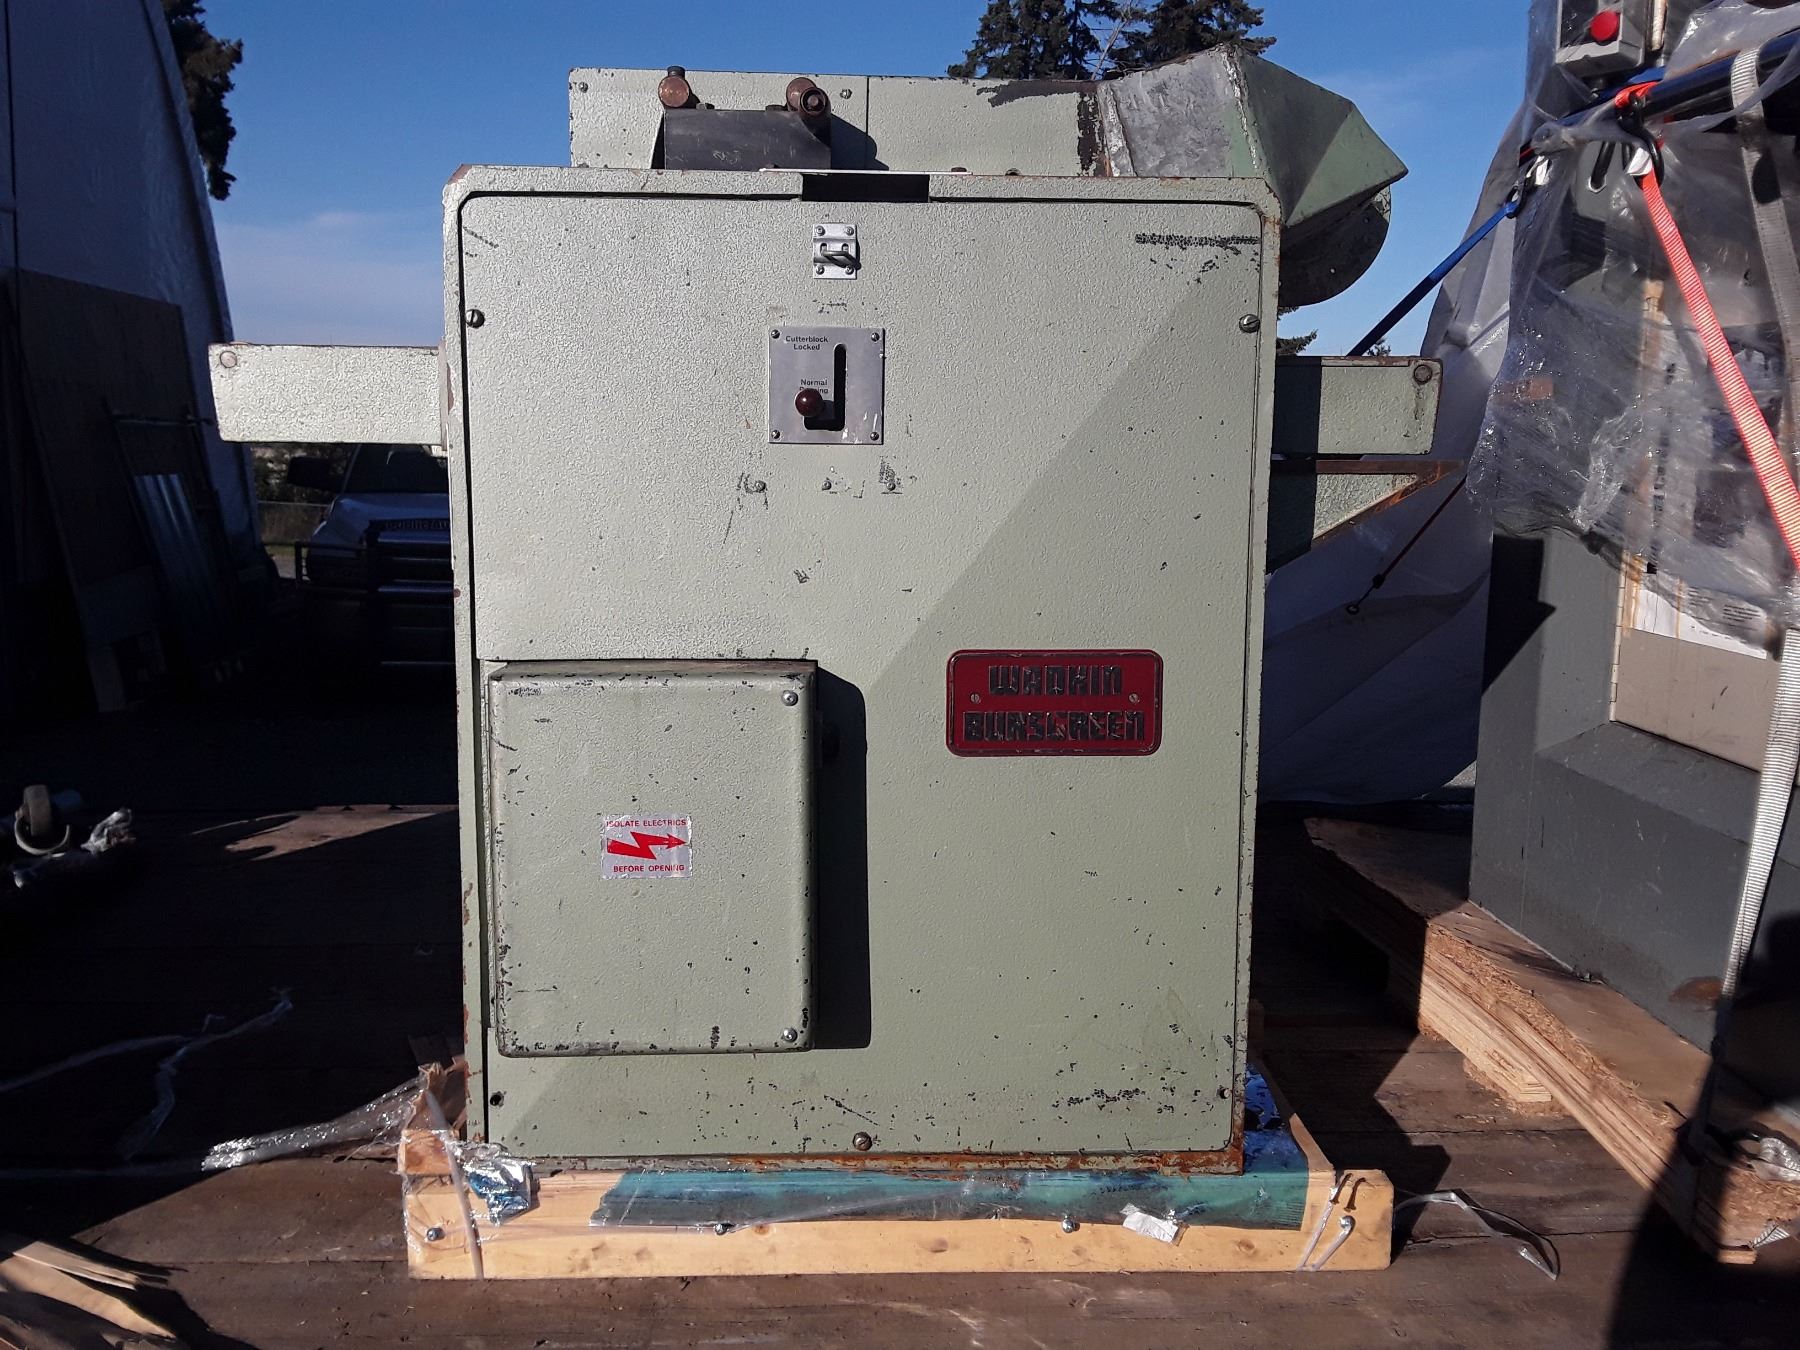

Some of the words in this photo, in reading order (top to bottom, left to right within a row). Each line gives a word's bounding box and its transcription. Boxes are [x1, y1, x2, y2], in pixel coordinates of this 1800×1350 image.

[785, 335, 829, 343] Cutterblock
[793, 343, 821, 351] Locked
[989, 666, 1122, 695] WADKIN
[606, 820, 640, 828] ISOLATE
[643, 819, 687, 827] ELECTRICS
[613, 865, 645, 873] BEFORE
[648, 864, 685, 872] OPENING
